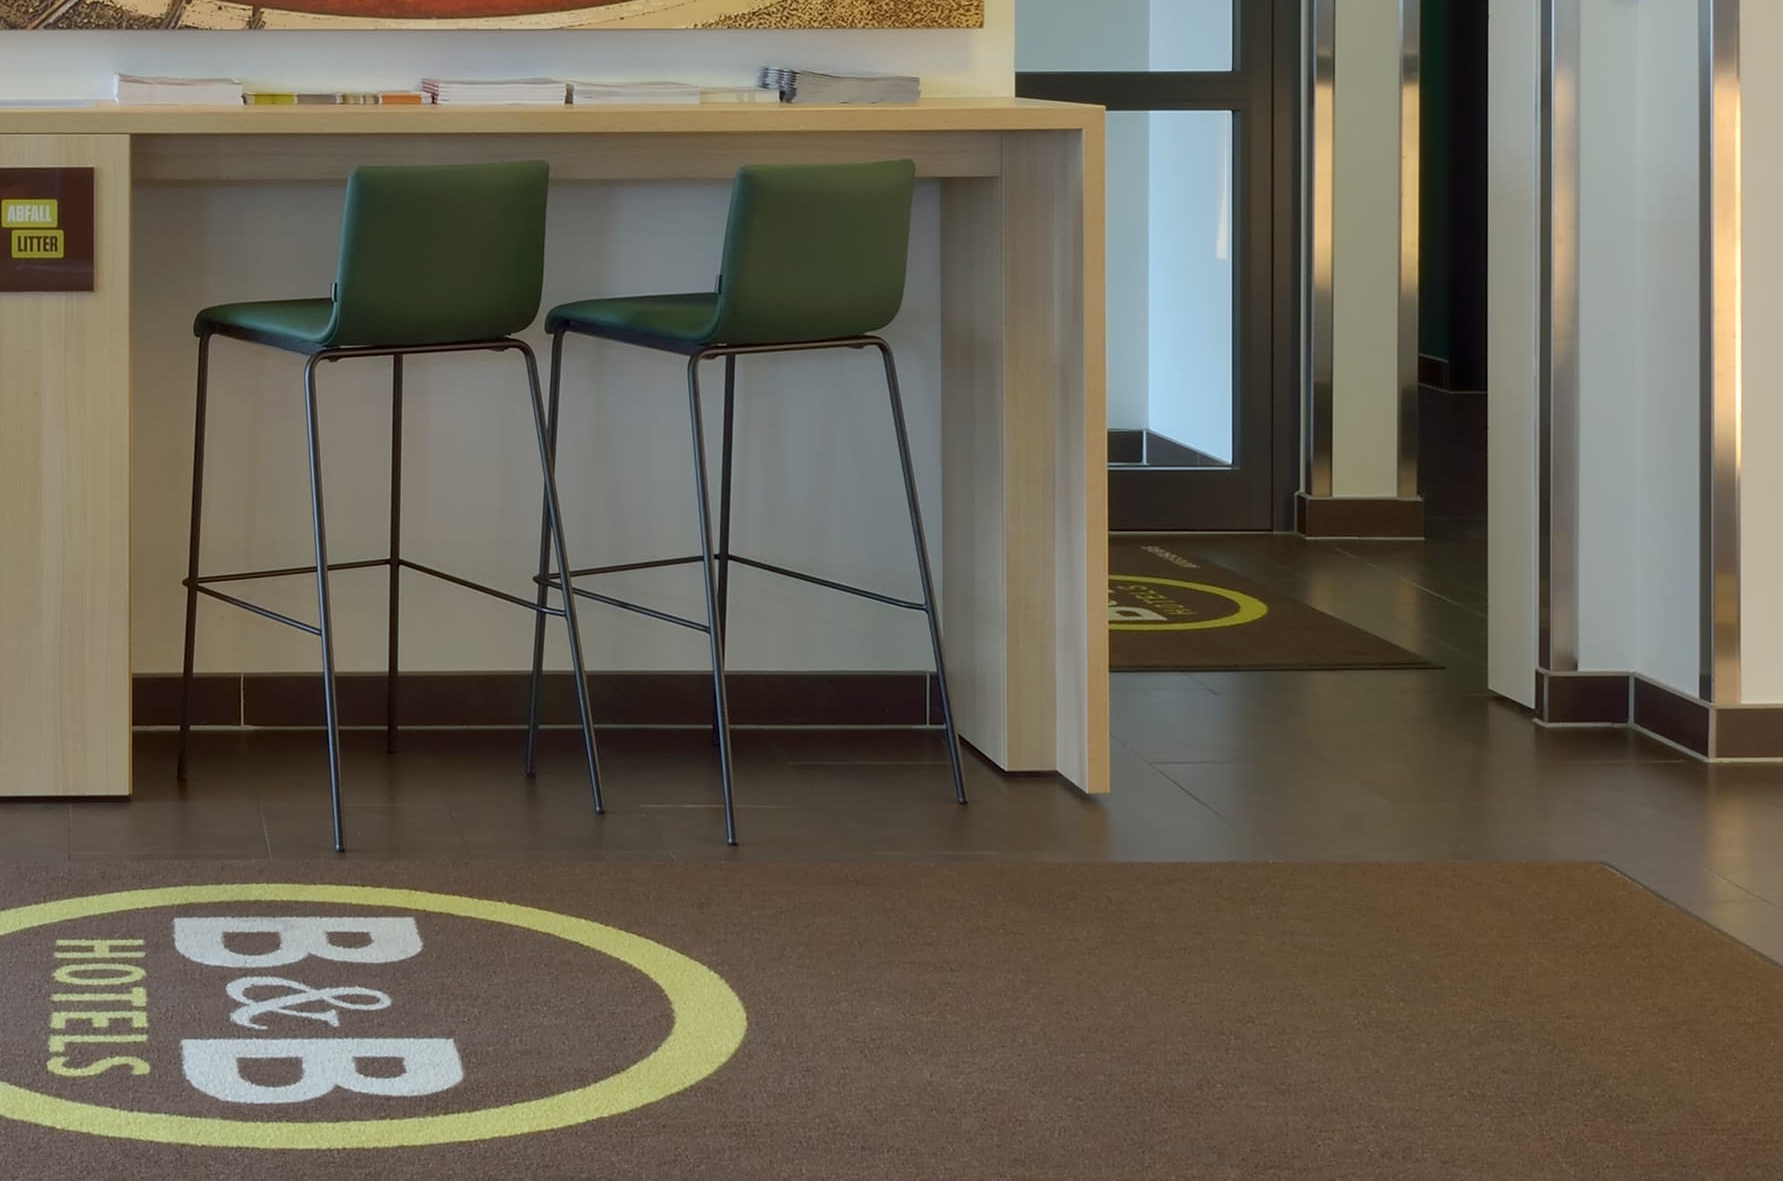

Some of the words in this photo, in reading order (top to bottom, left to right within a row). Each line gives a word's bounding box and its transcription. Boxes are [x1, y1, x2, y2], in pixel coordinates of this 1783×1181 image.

[7, 205, 52, 222] ABFALL
[18, 235, 58, 252] LITTER
[47, 937, 151, 1079] HOTELS
[173, 916, 464, 1104] B&B
